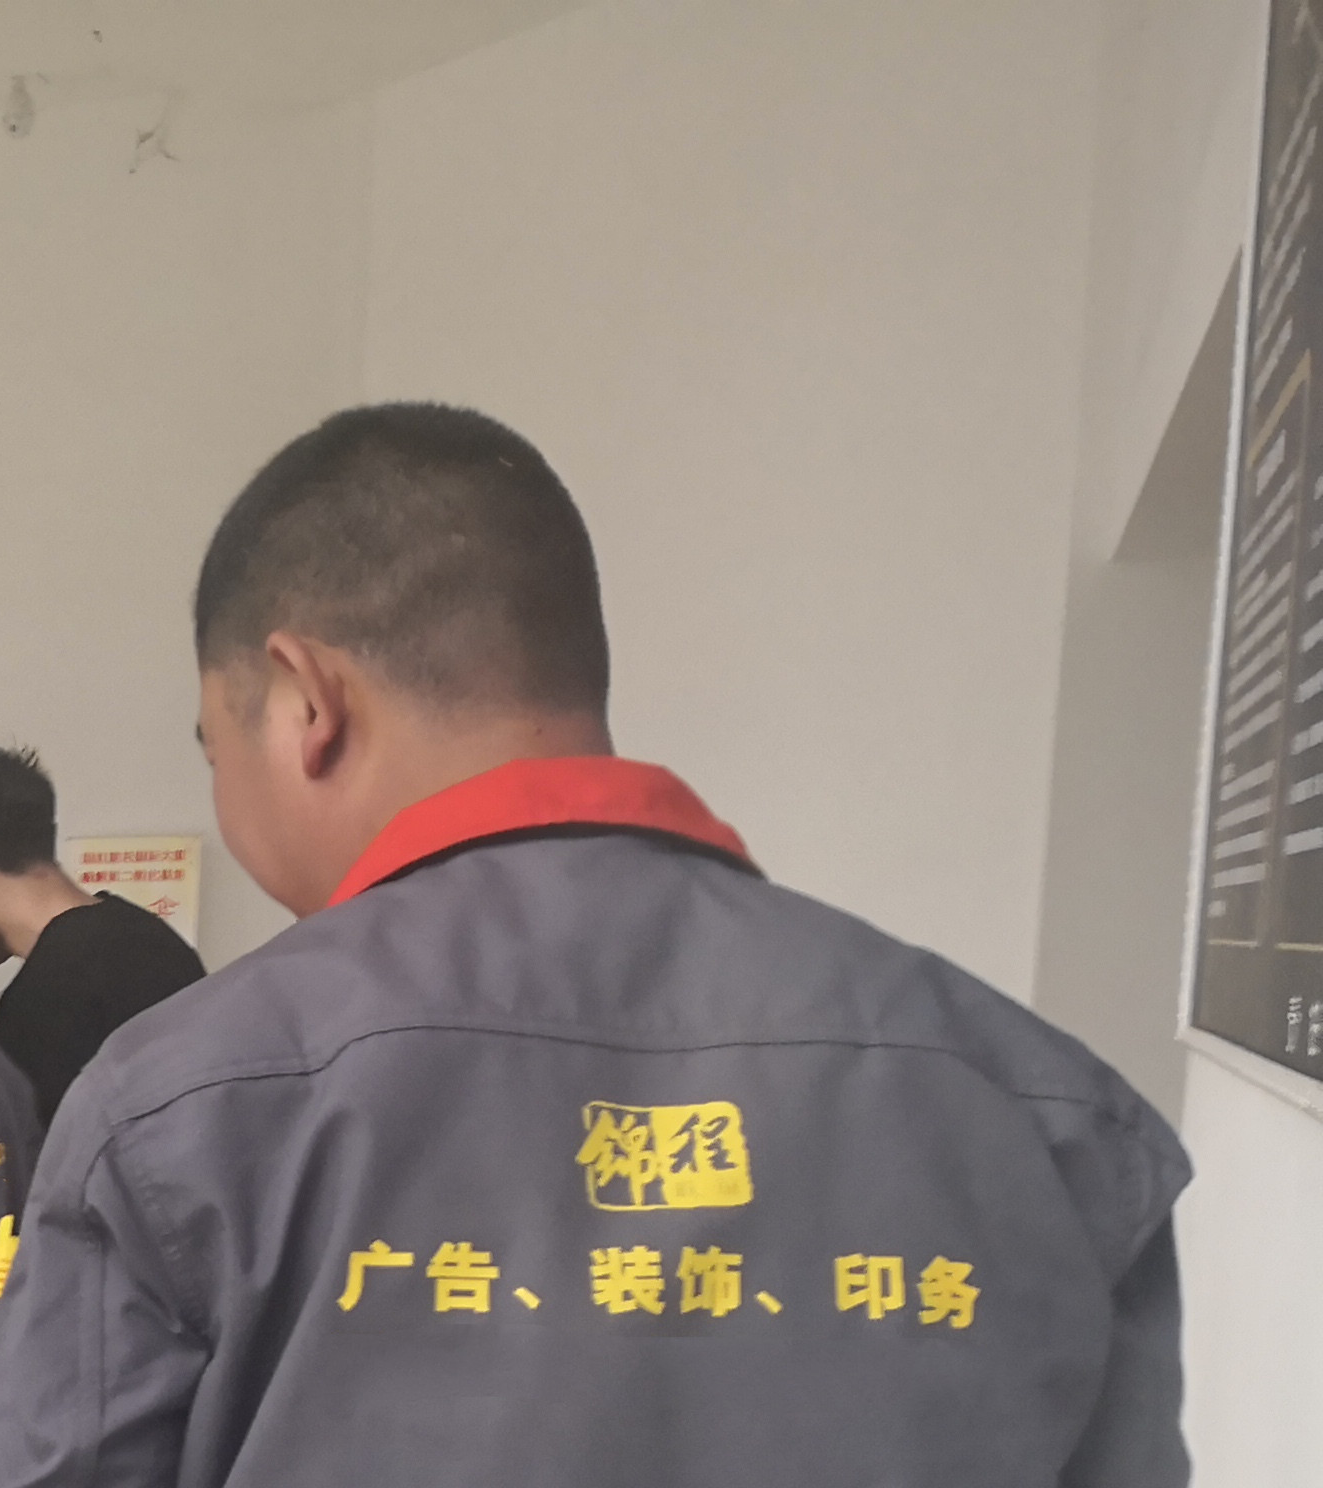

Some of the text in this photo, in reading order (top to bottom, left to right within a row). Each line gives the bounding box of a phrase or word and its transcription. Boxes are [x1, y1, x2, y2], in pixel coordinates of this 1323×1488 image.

[577, 1103, 752, 1210] 锦程
[337, 1240, 981, 1329] 广告、装饰、印务
